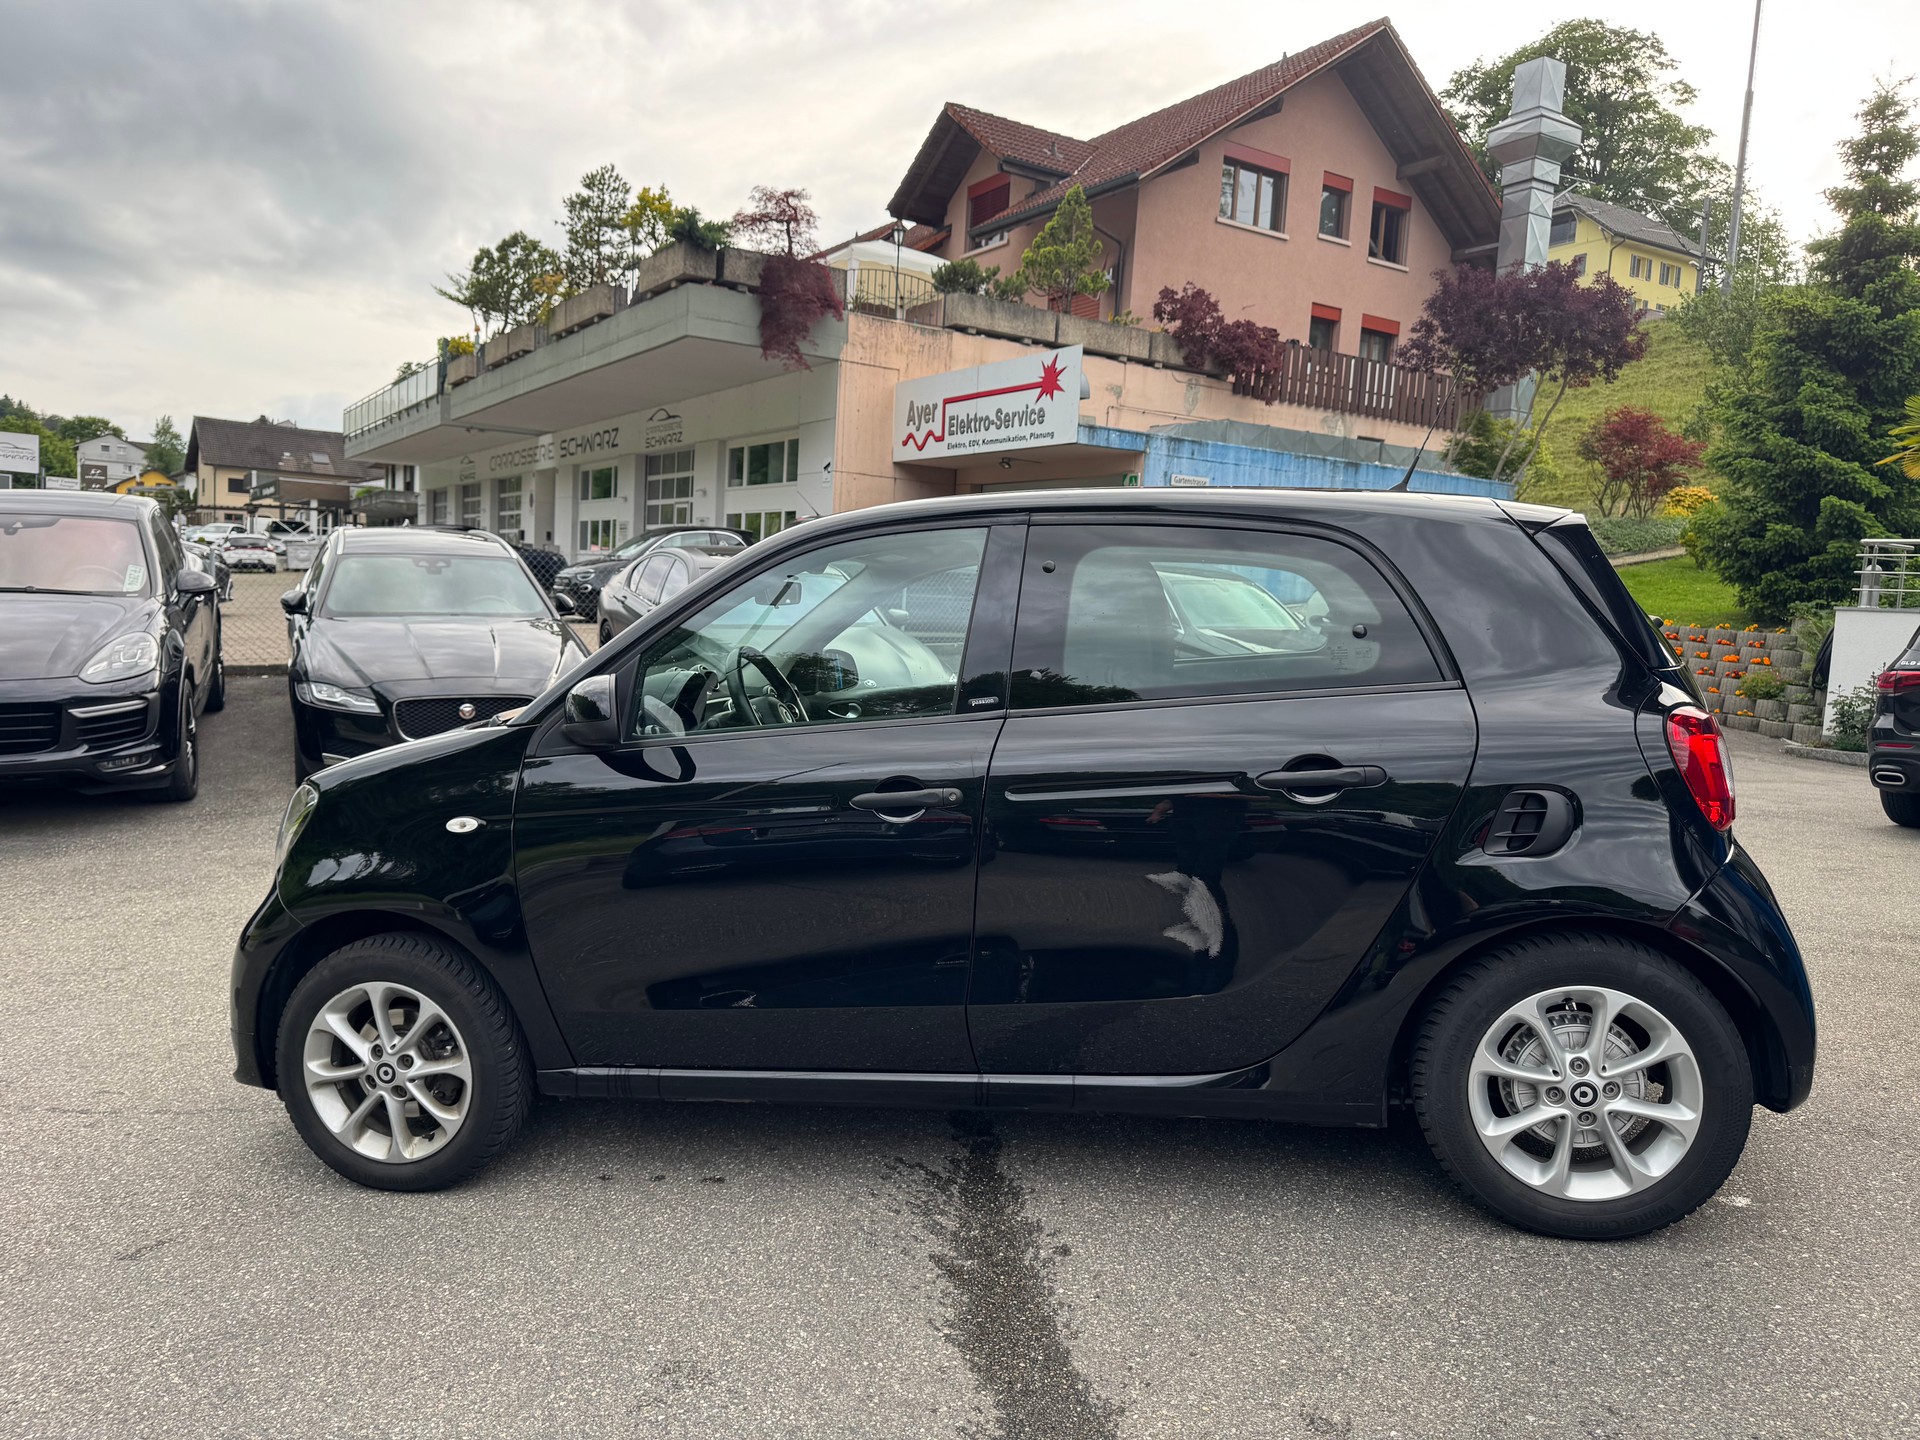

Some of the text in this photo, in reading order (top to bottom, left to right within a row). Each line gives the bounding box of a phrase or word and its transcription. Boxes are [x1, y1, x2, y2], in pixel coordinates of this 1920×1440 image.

[906, 400, 938, 431] Ayer
[948, 404, 1045, 436] Elektro-Service
[489, 427, 619, 471] CARROSSERIE SCHWARZ
[645, 431, 682, 449] SCHWARZ
[981, 434, 1028, 446] Kommunikation,
[1029, 431, 1055, 440] Planung
